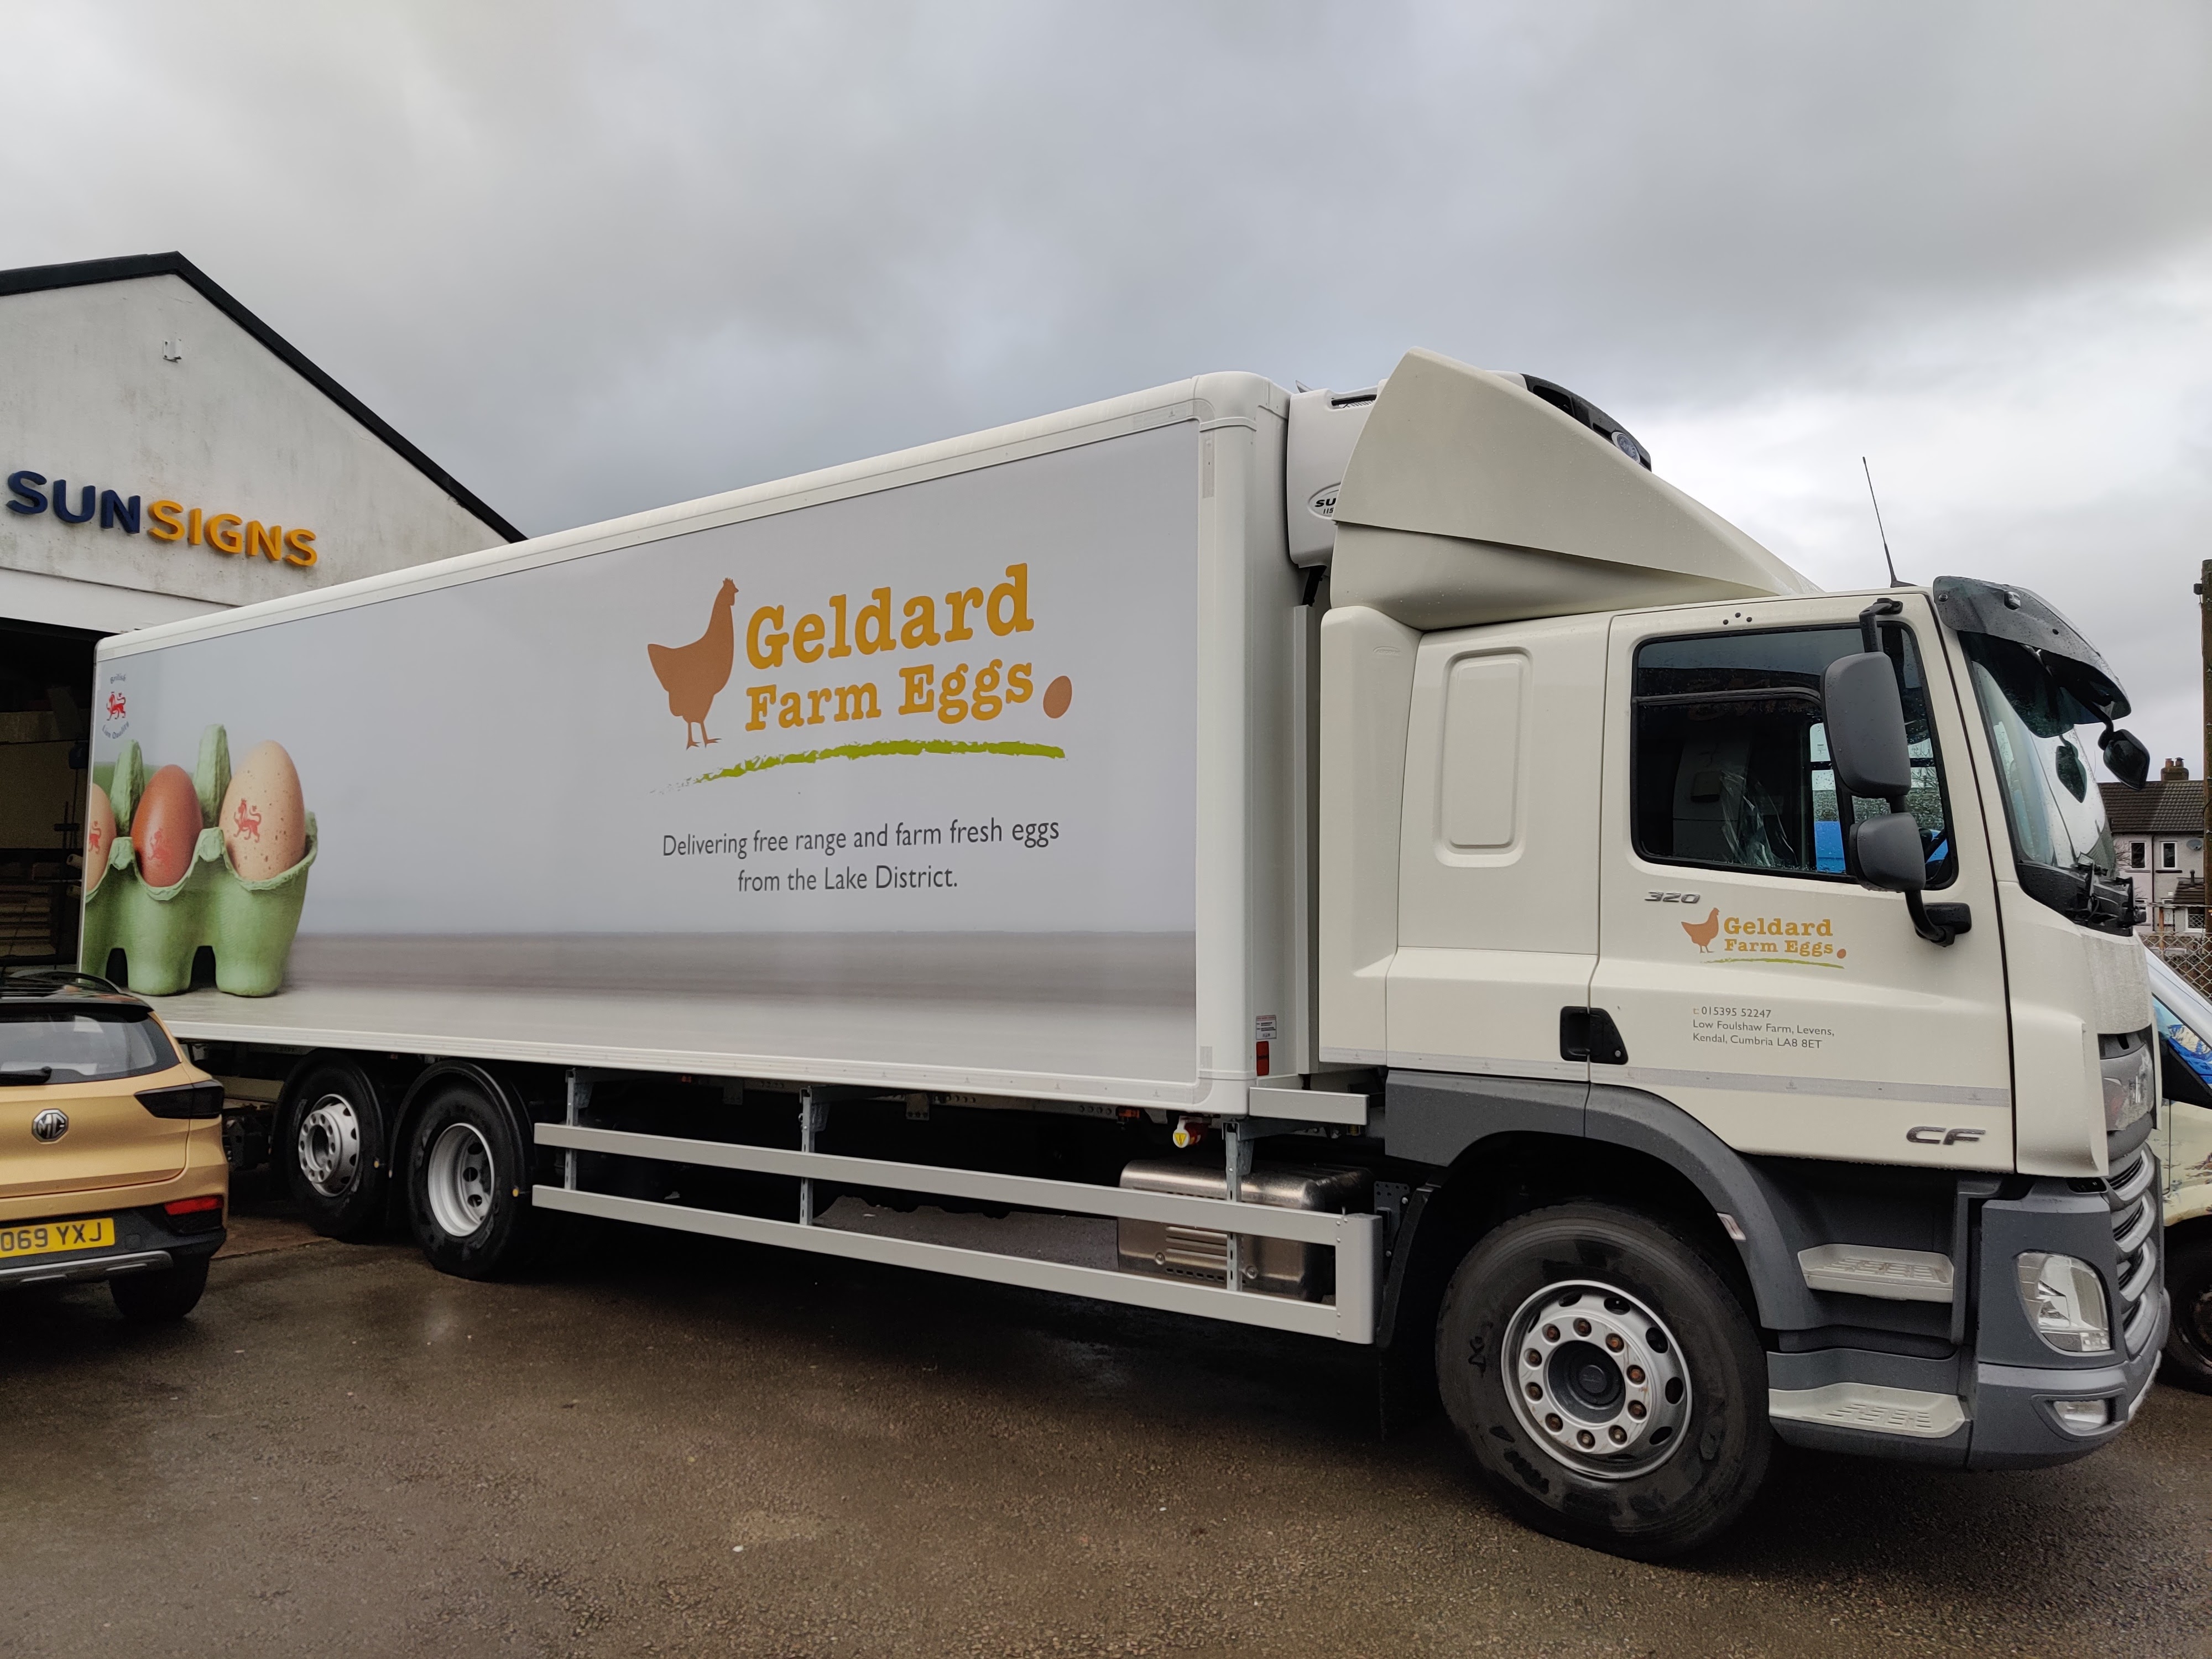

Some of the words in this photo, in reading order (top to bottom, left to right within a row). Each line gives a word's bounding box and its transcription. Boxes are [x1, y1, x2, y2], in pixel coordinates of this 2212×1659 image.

[746, 563, 1035, 670] Geldard
[745, 681, 881, 732] Farm
[898, 659, 1034, 724] Eggs
[663, 832, 748, 860] Delivering
[753, 830, 788, 852] free
[796, 832, 846, 856] range
[854, 823, 888, 848] and
[895, 822, 941, 846] farm
[950, 817, 1002, 843] fresh
[1012, 821, 1059, 848] eggs
[738, 869, 780, 892] from
[787, 868, 816, 891] the
[825, 866, 867, 890] Lake
[876, 864, 957, 889] District.
[1645, 891, 1700, 904] 320
[1723, 916, 1833, 937] Geldard
[1724, 938, 1778, 952] Farm
[1784, 940, 1834, 957] Eggs
[1701, 1006, 1737, 1016] 015395
[1741, 1008, 1771, 1018] 52247
[1693, 1019, 1714, 1029] Low
[1717, 1020, 1762, 1031] Foulshaw
[1766, 1023, 1794, 1035] Farm,
[1797, 1025, 1835, 1037] Levens,
[1693, 1032, 1728, 1044] Kendal,
[1730, 1035, 1773, 1046] Cumbria
[1777, 1038, 1798, 1047] LA8
[1801, 1039, 1823, 1048] 8ET
[1906, 1126, 1986, 1145] CF
[56, 1222, 102, 1245] YXJ
